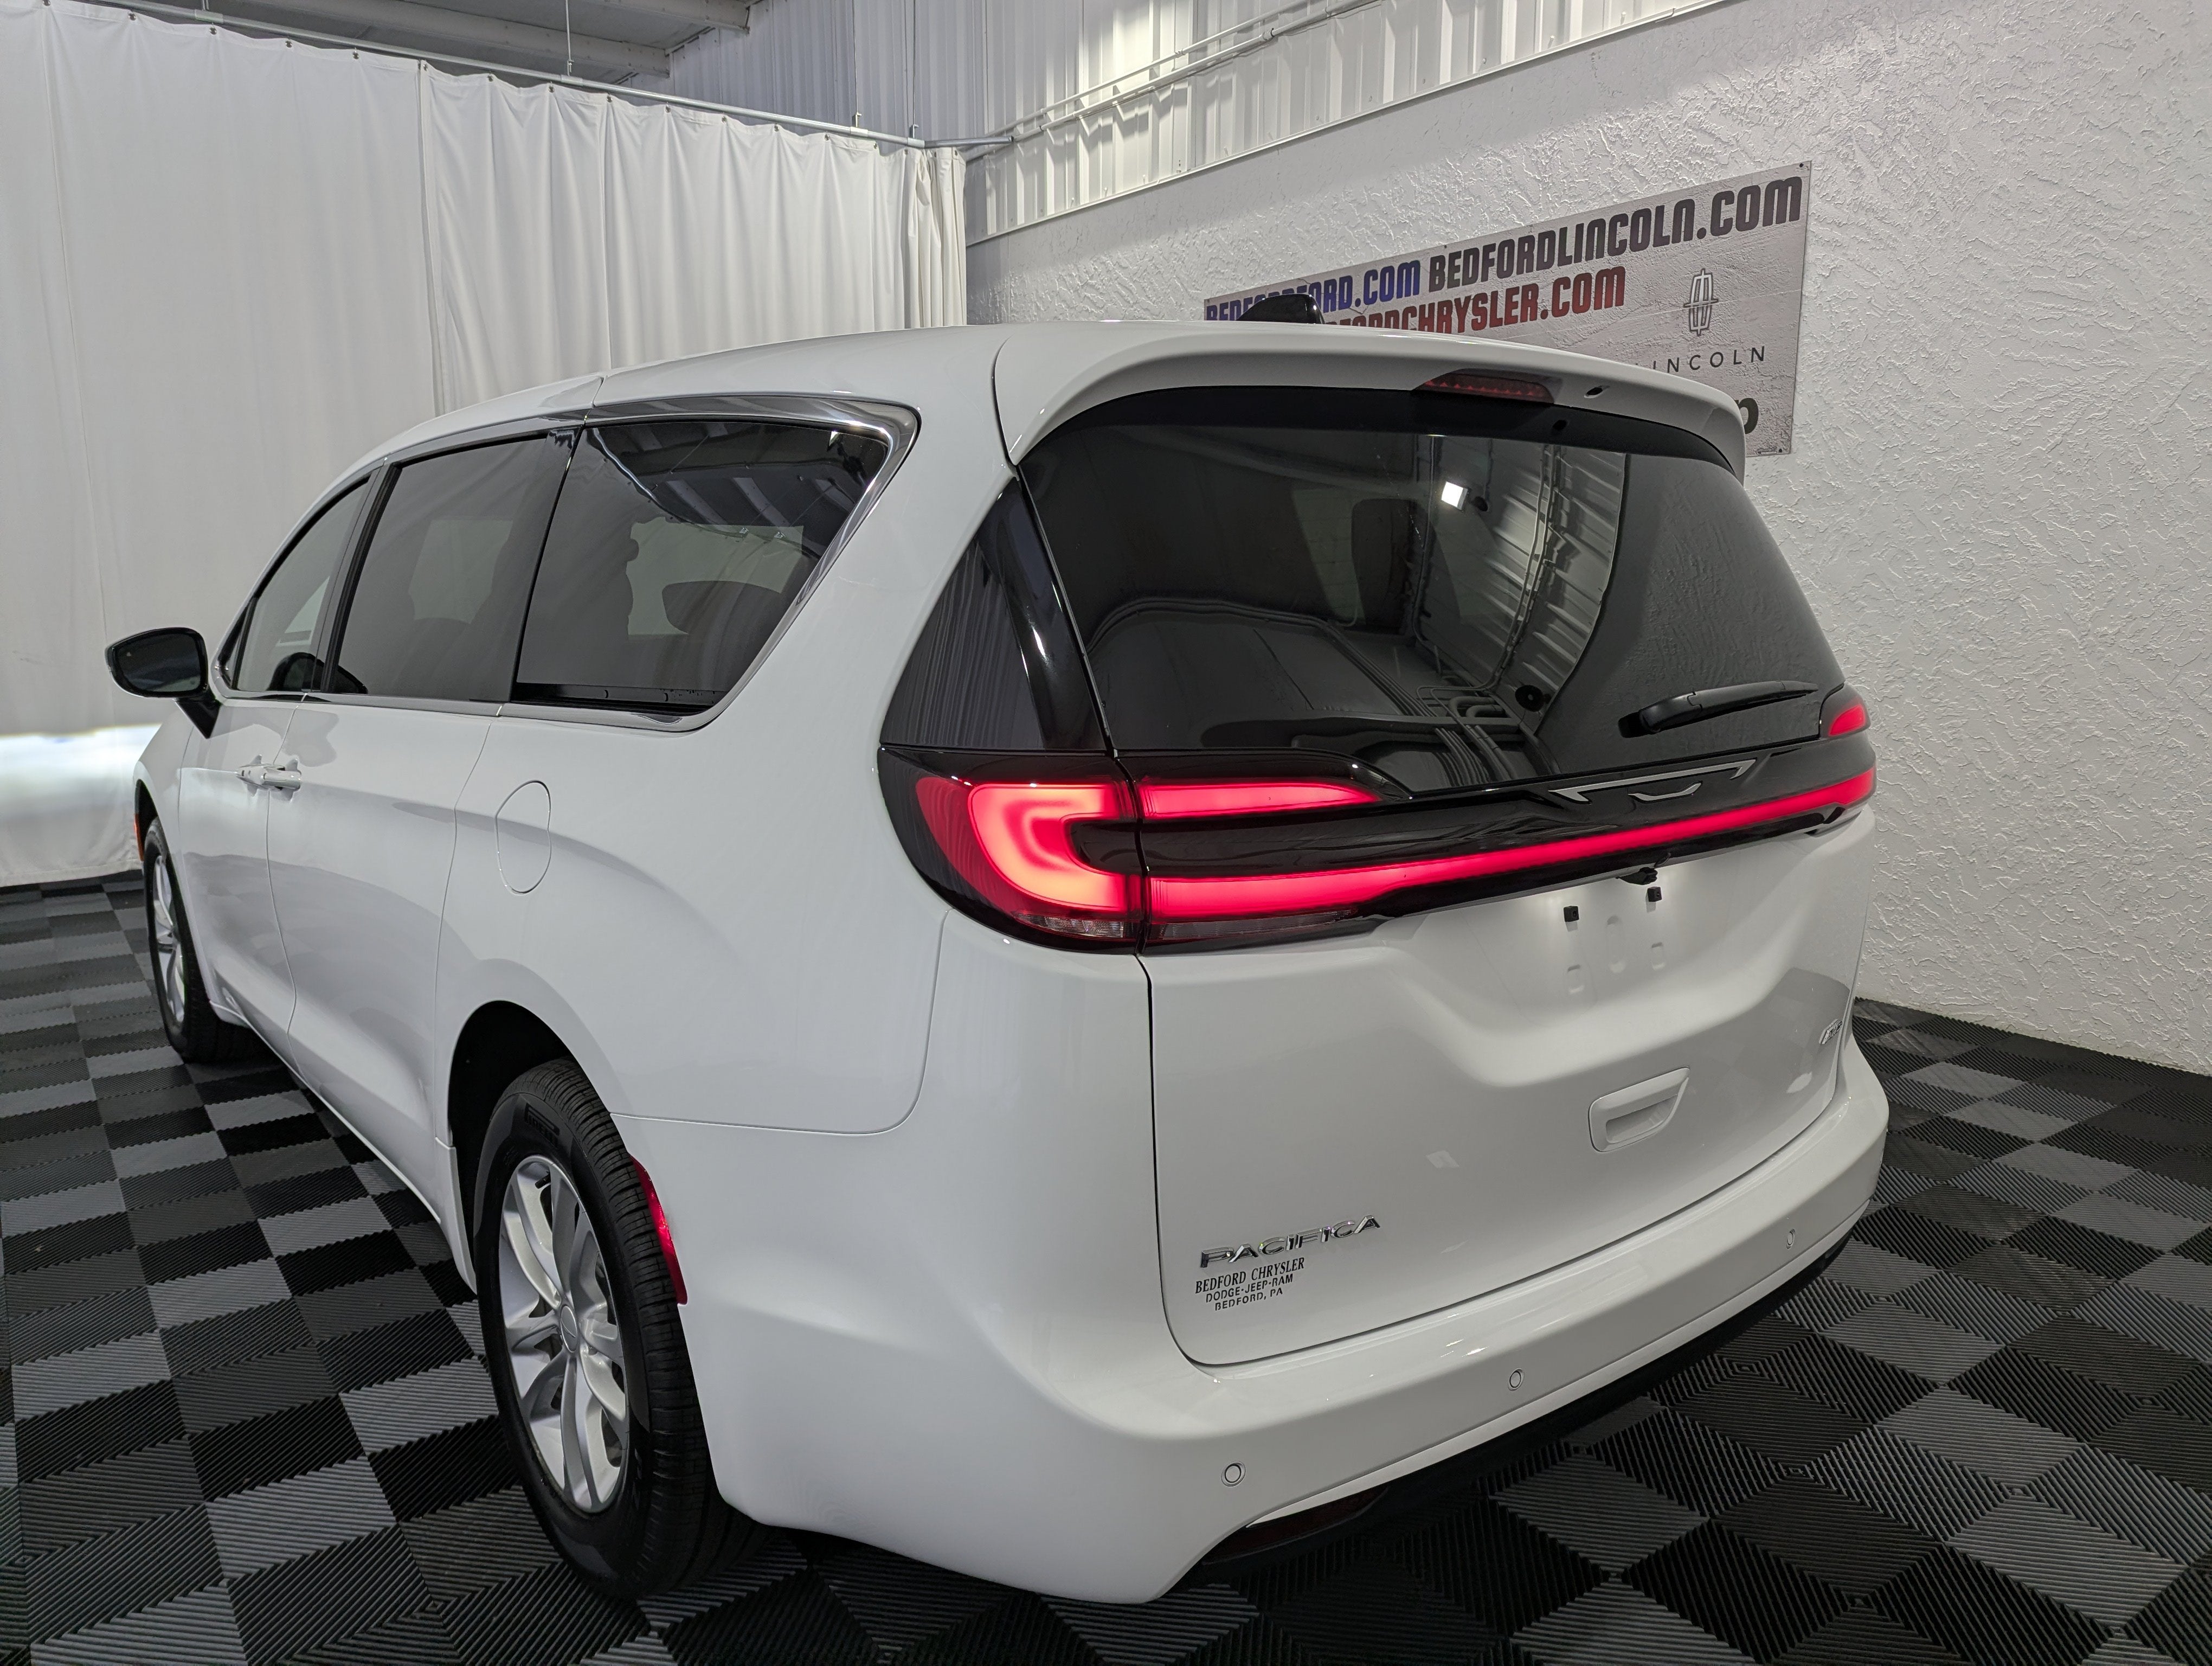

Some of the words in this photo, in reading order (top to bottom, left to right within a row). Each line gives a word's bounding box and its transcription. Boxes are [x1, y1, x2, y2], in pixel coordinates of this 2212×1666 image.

[1429, 176, 1802, 292] BEDFORDLINCOLN.COM
[1635, 345, 1765, 373] INCOLN
[1200, 1214, 1381, 1268] PACIFICA
[1195, 1271, 1246, 1294] BEDFORD
[1251, 1257, 1305, 1281] CHRYSLER
[1214, 1292, 1267, 1311] BEDFORD,
[1270, 1287, 1283, 1298] PA
